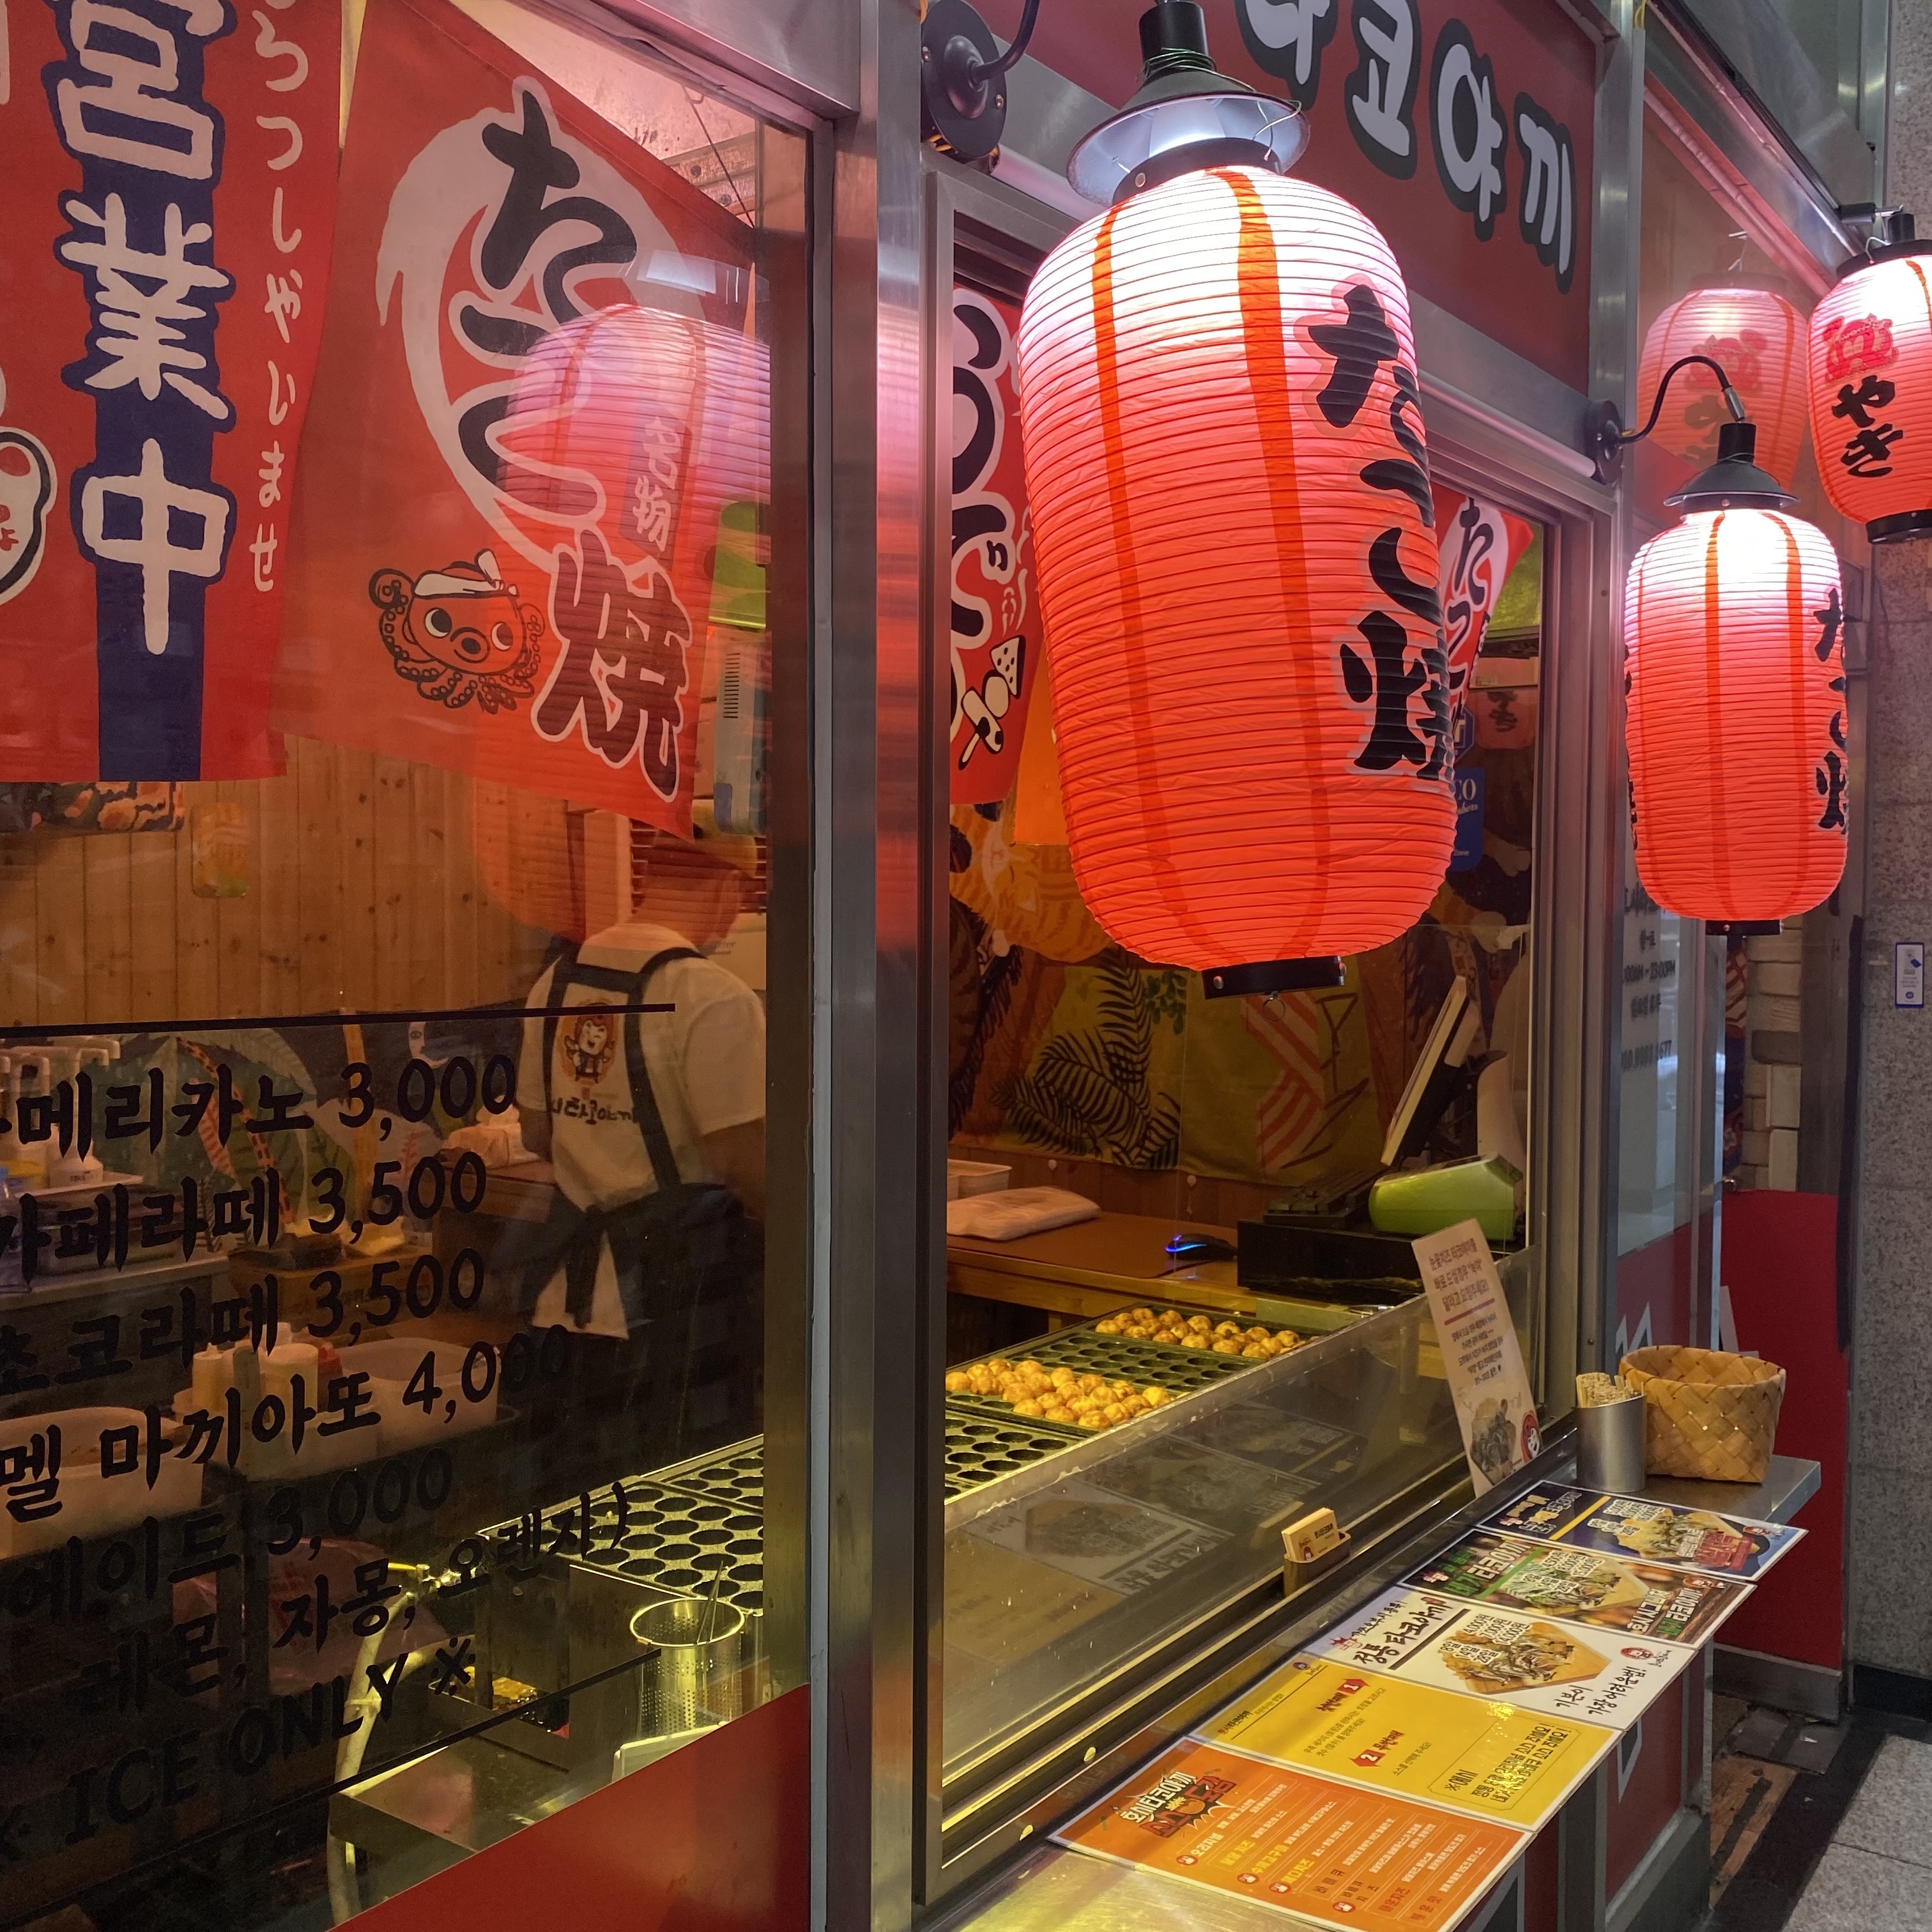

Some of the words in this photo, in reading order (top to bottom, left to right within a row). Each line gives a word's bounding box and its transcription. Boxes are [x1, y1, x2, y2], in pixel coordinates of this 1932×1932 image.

[0, 1064, 314, 1162] 메리카노
[338, 1054, 515, 1142] 3,000
[309, 1151, 487, 1245] 3,500
[307, 1248, 486, 1347] 3,500
[100, 1371, 382, 1492] 마끼아또
[402, 1324, 573, 1424] 4,000
[266, 1446, 448, 1561] 3,000
[272, 1558, 417, 1653] 자몽,
[437, 1481, 628, 1598] 오렌지)
[1373, 1600, 1457, 1647] 타코야끼
[1346, 1642, 1405, 1667] 정통
[1437, 1641, 1463, 1652] 8알
[1453, 1644, 1482, 1659] 14알
[1471, 1649, 1500, 1664] 28알
[1548, 1684, 1594, 1710] 기본이
[1580, 1697, 1620, 1717] 가장
[65, 1732, 199, 1845] ICE
[227, 1652, 410, 1777] ONLY
[1370, 1729, 1409, 1752] 두번째
[1531, 1747, 1554, 1759] 소스
[1469, 1784, 1495, 1798] 정통
[1514, 1741, 1537, 1754] 소스
[1116, 1770, 1199, 1823] 호시타코야끼
[1187, 1832, 1226, 1857] 오리지널
[1232, 1839, 1257, 1853] 치즈
[1247, 1844, 1291, 1874] 수제고구마
[1279, 1858, 1316, 1884] 체다치즈
[1376, 1887, 1413, 1913] 매운치즈
